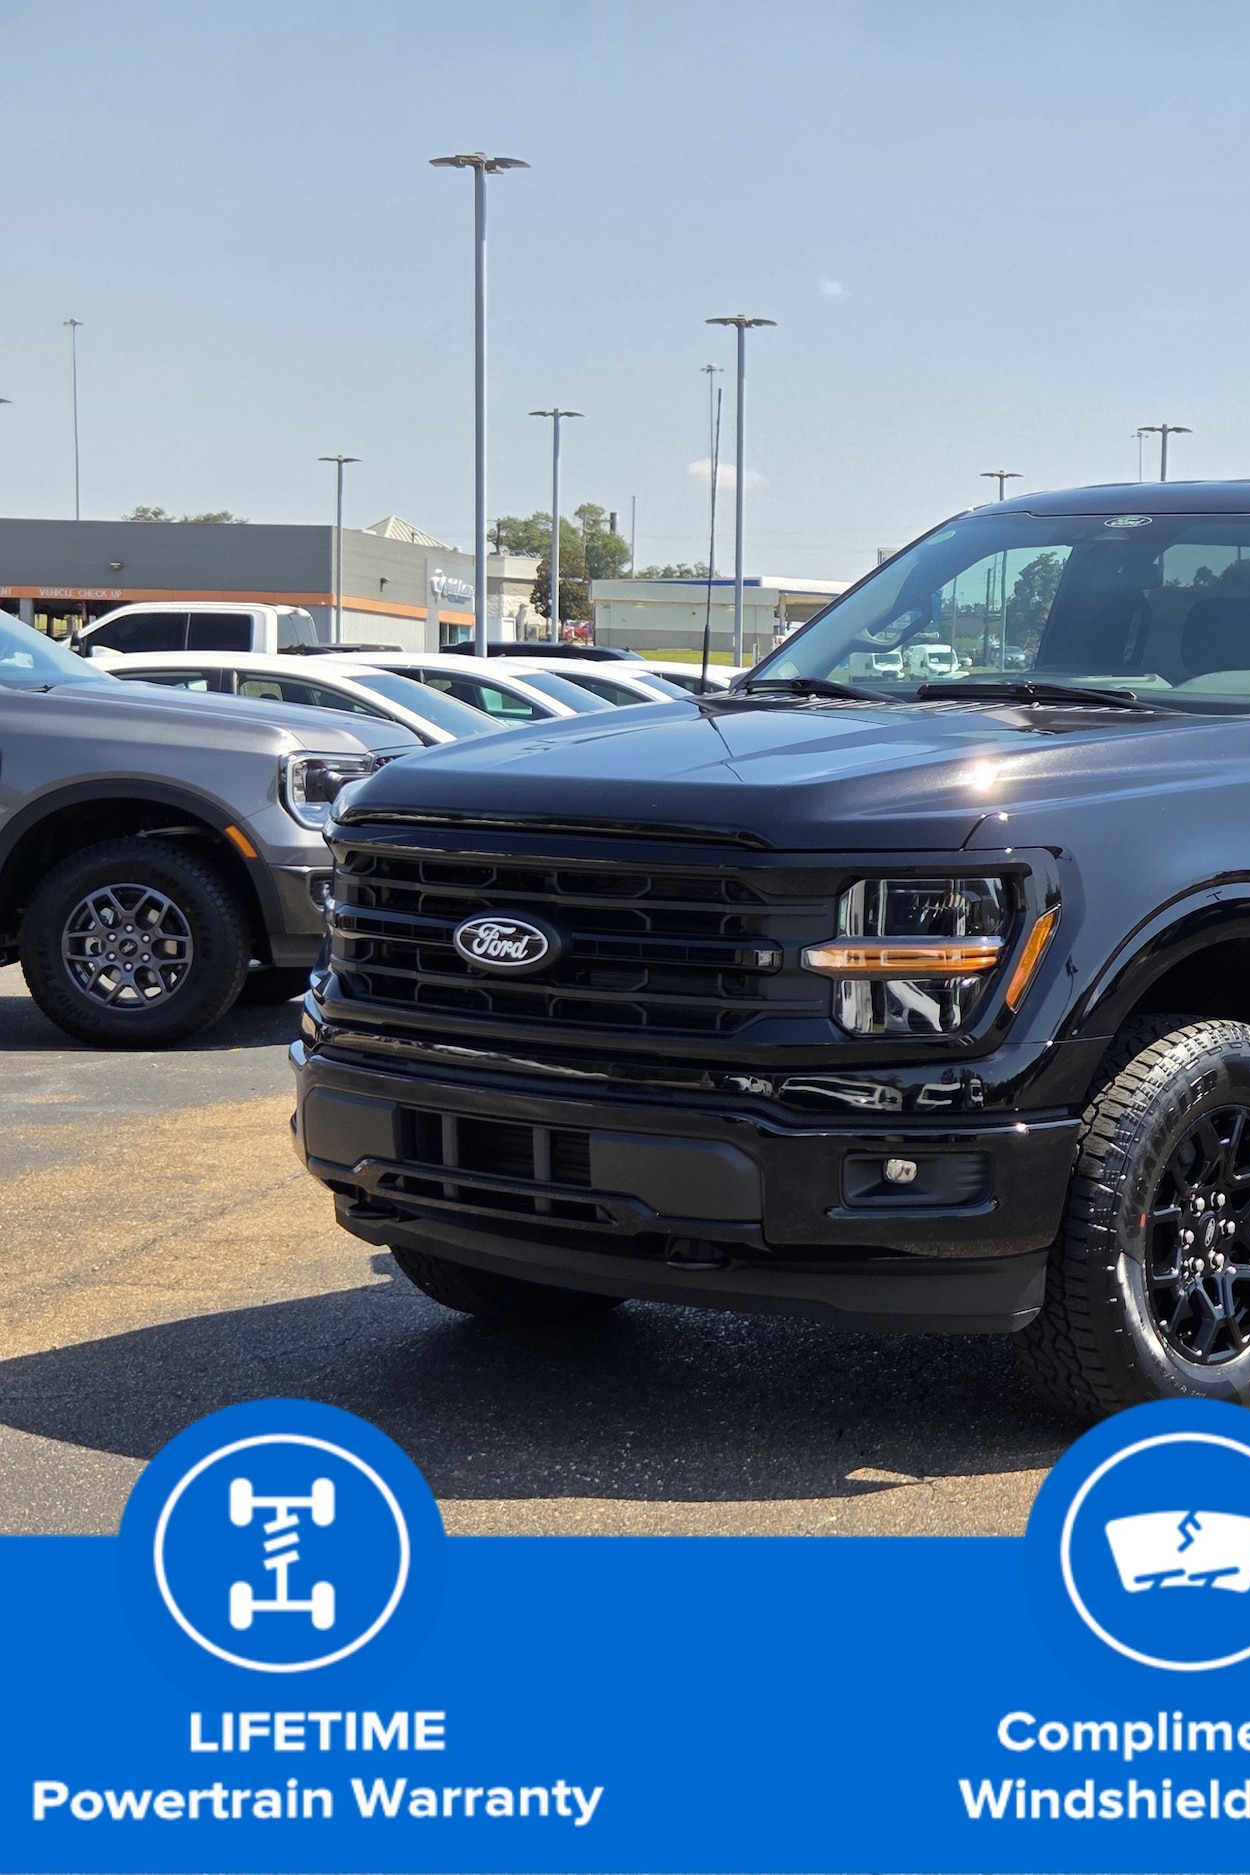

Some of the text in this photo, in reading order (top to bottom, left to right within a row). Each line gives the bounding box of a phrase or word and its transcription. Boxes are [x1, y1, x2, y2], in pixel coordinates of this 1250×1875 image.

[39, 587, 122, 598] VEHICLE CHECK UP
[472, 923, 528, 959] Ford
